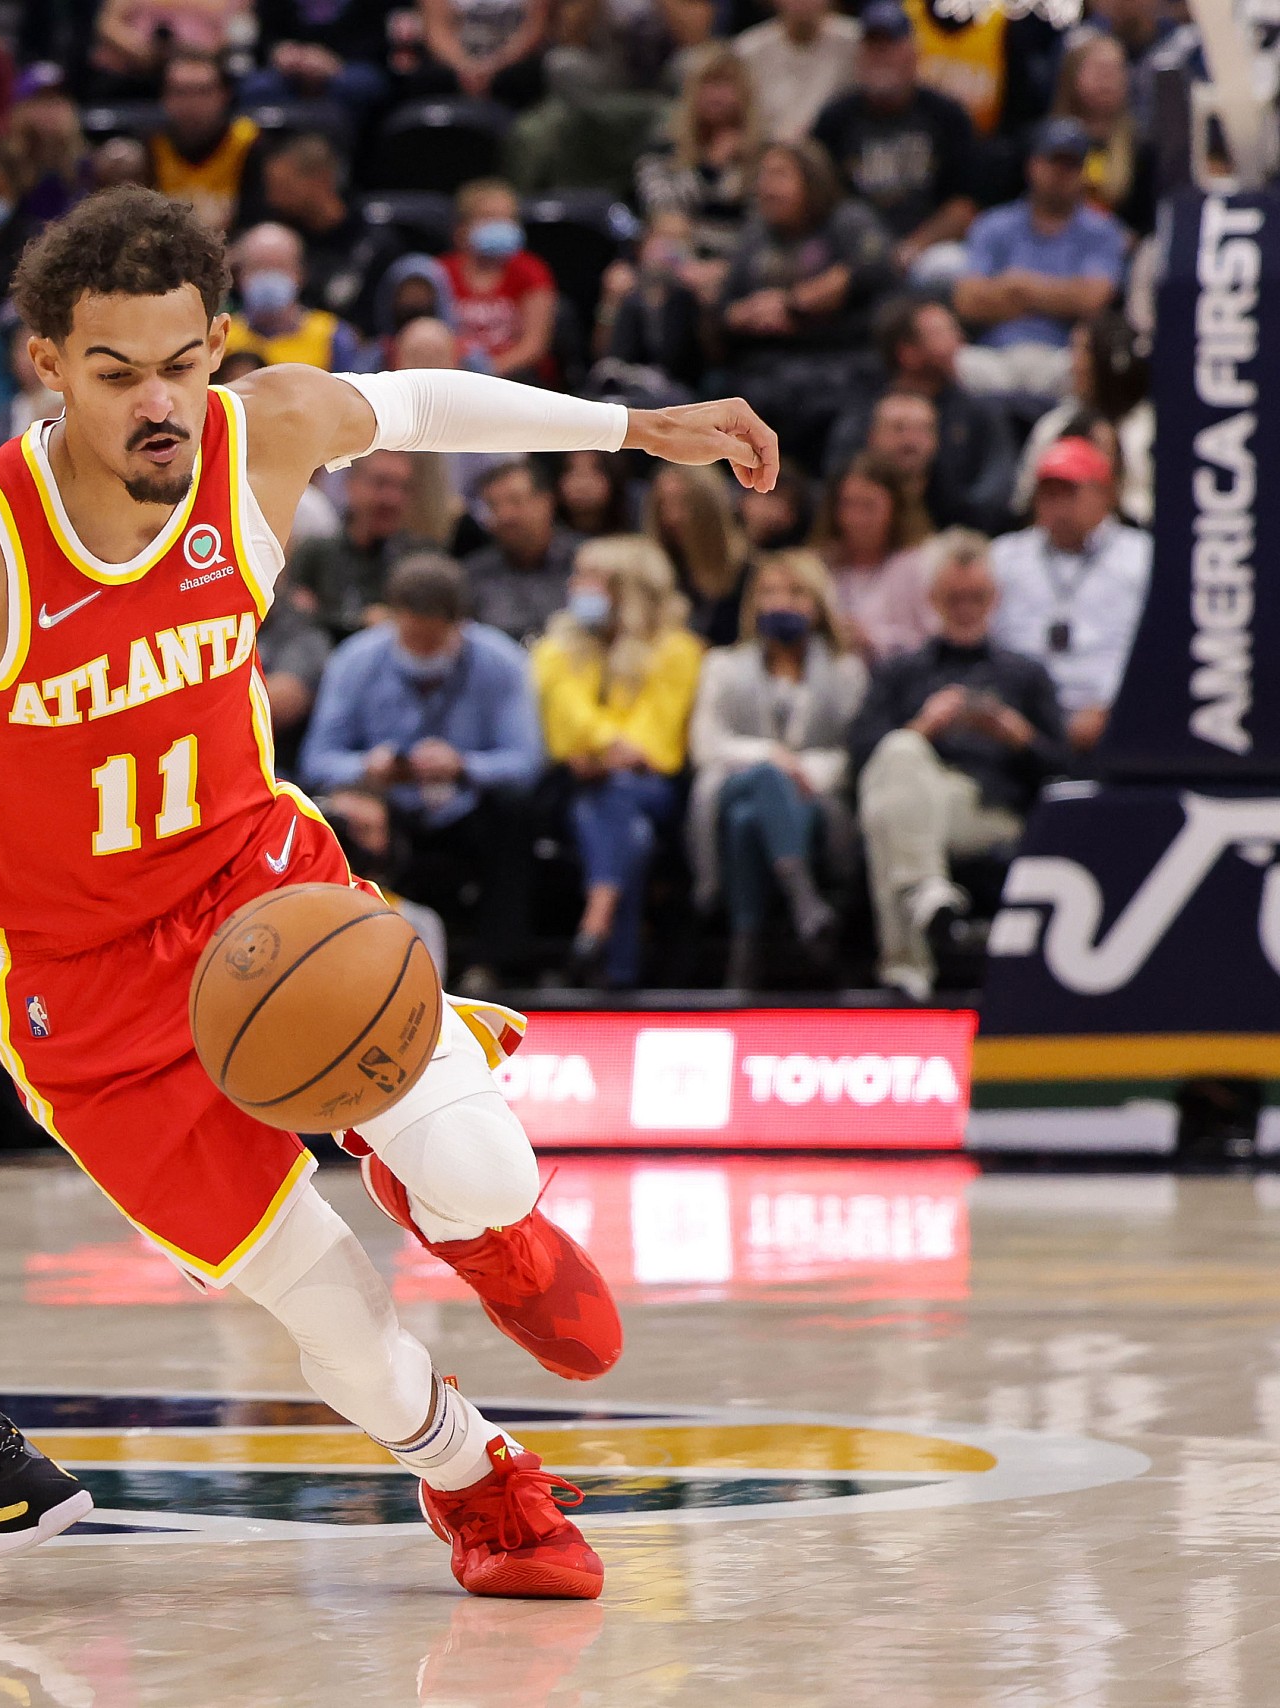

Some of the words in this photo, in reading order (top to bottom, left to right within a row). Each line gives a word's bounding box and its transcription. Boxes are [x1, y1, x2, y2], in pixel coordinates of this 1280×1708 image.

[1193, 190, 1266, 408] FIRST
[179, 565, 235, 592] sharecare
[1189, 408, 1260, 757] AMERICA
[8, 612, 257, 727] ATLANTA
[91, 733, 202, 857] 11
[743, 1053, 959, 1106] TOYOTA
